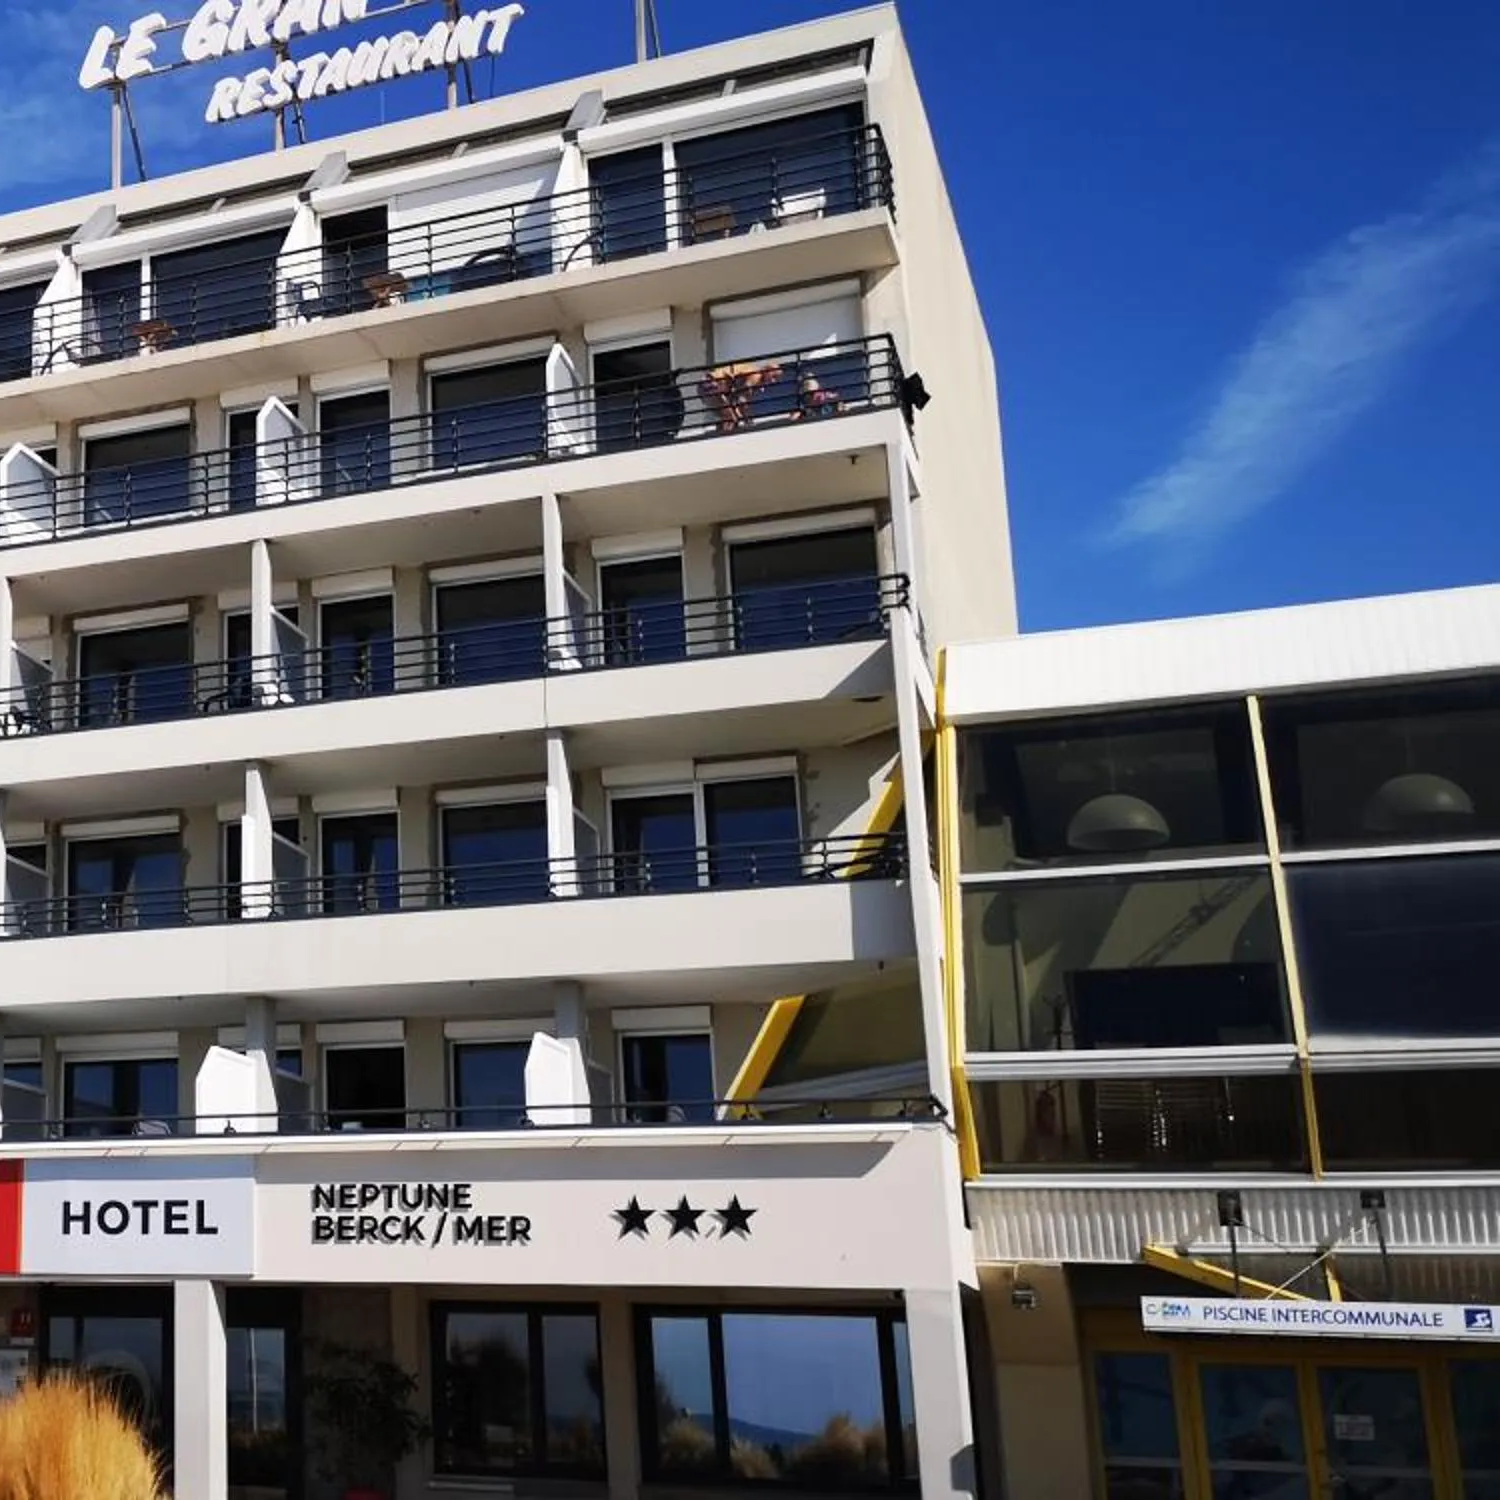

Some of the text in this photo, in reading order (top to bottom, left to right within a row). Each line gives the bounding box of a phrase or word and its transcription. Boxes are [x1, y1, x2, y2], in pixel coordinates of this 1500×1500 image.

[79, 13, 167, 89] LE
[204, 3, 526, 123] RESTAURANT
[312, 1184, 473, 1210] NEPTUNE
[61, 1199, 219, 1235] HOTEL
[313, 1216, 425, 1242] BERCK
[456, 1216, 532, 1242] MER
[1203, 1306, 1268, 1324] PISCINE
[1272, 1307, 1445, 1328] INTERCOMMUNALE
